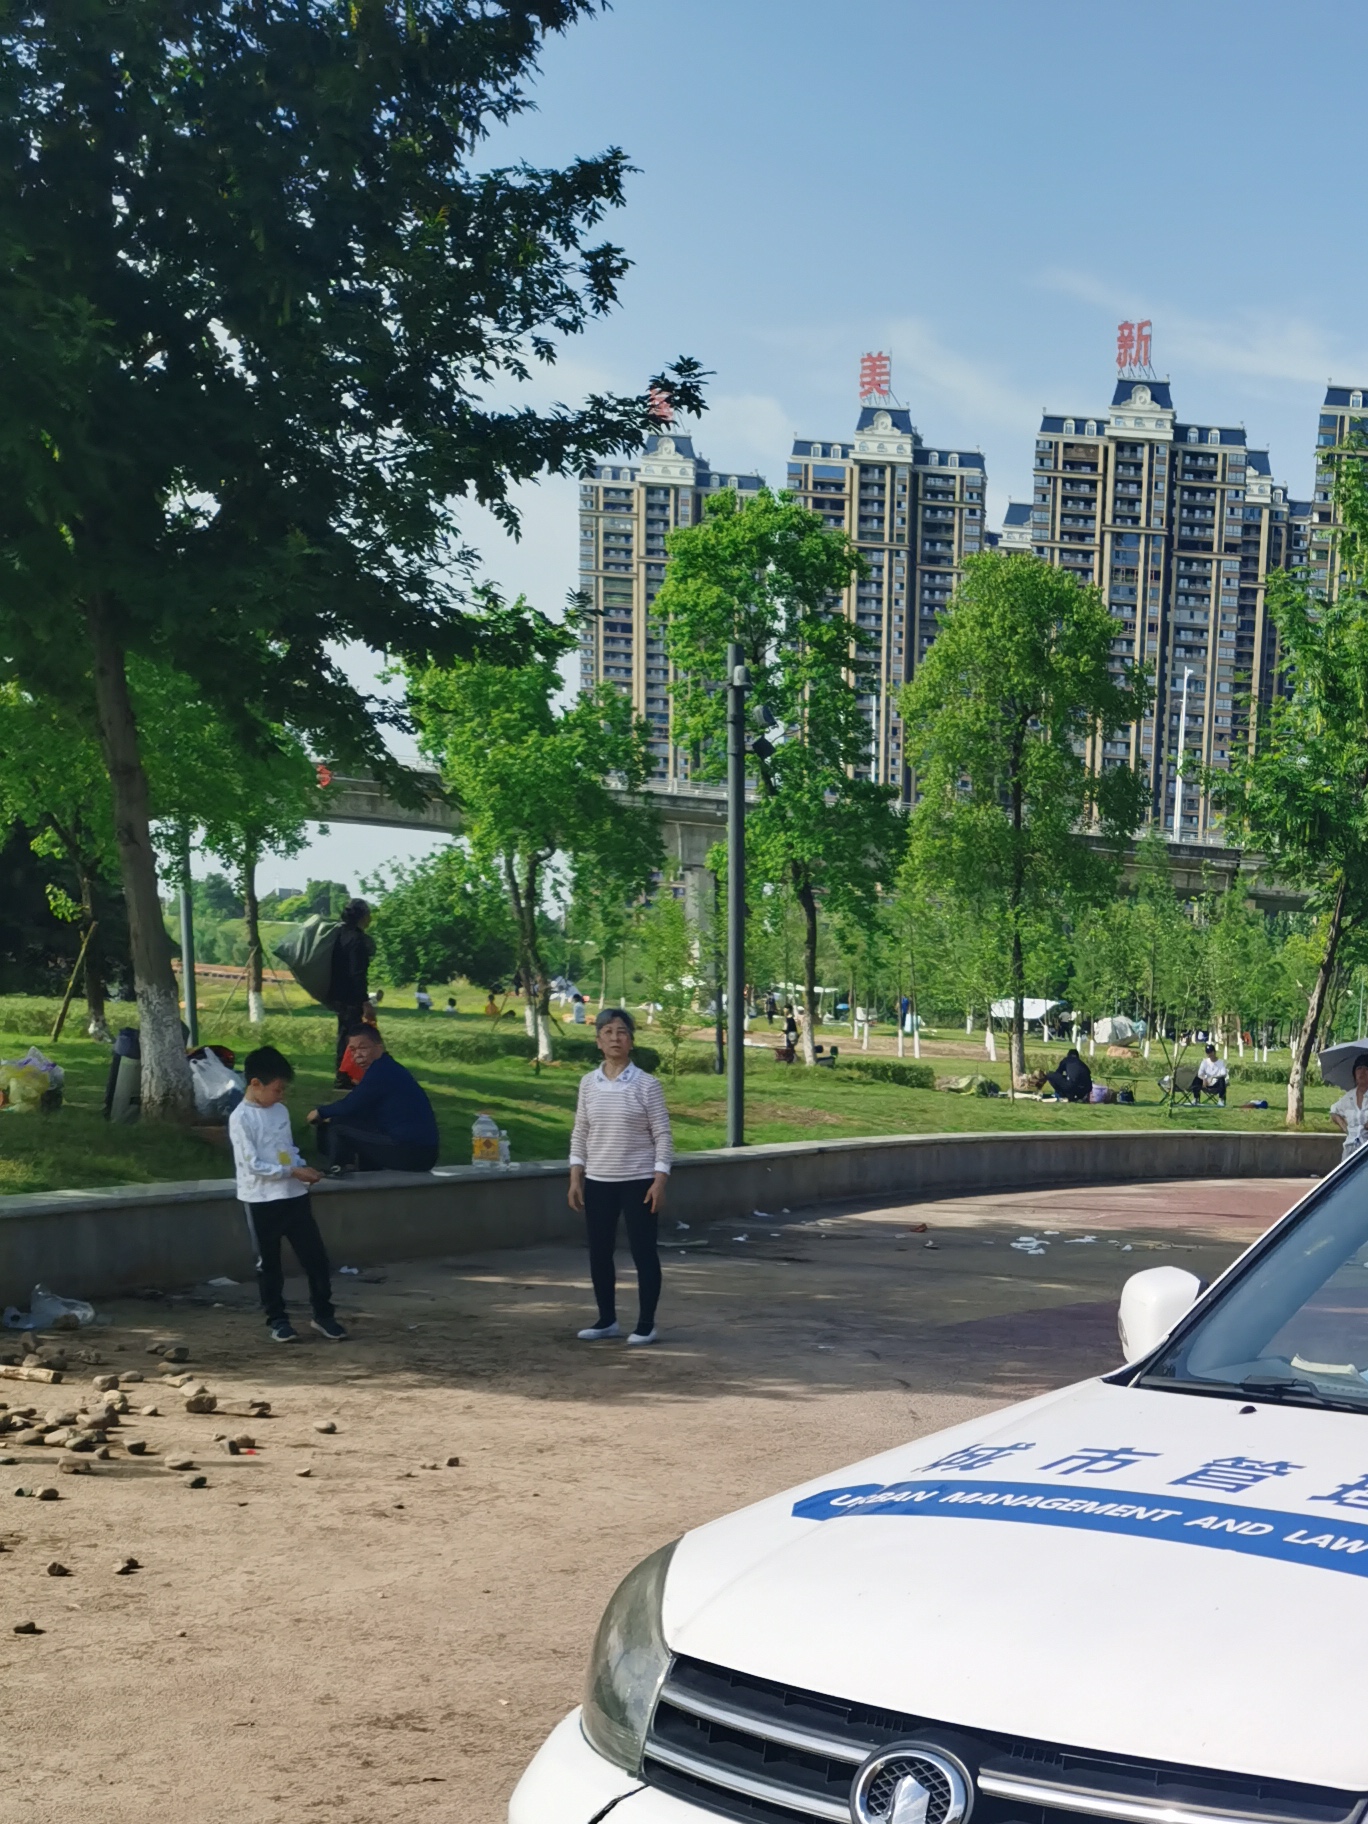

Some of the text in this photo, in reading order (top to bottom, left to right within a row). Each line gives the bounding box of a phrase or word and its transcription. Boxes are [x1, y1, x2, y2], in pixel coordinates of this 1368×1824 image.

[1116, 319, 1151, 369] 新
[859, 350, 891, 397] 美
[830, 1489, 940, 1509] URBAN
[939, 1491, 1183, 1522] MANAGEMENT
[1183, 1516, 1274, 1537] AND
